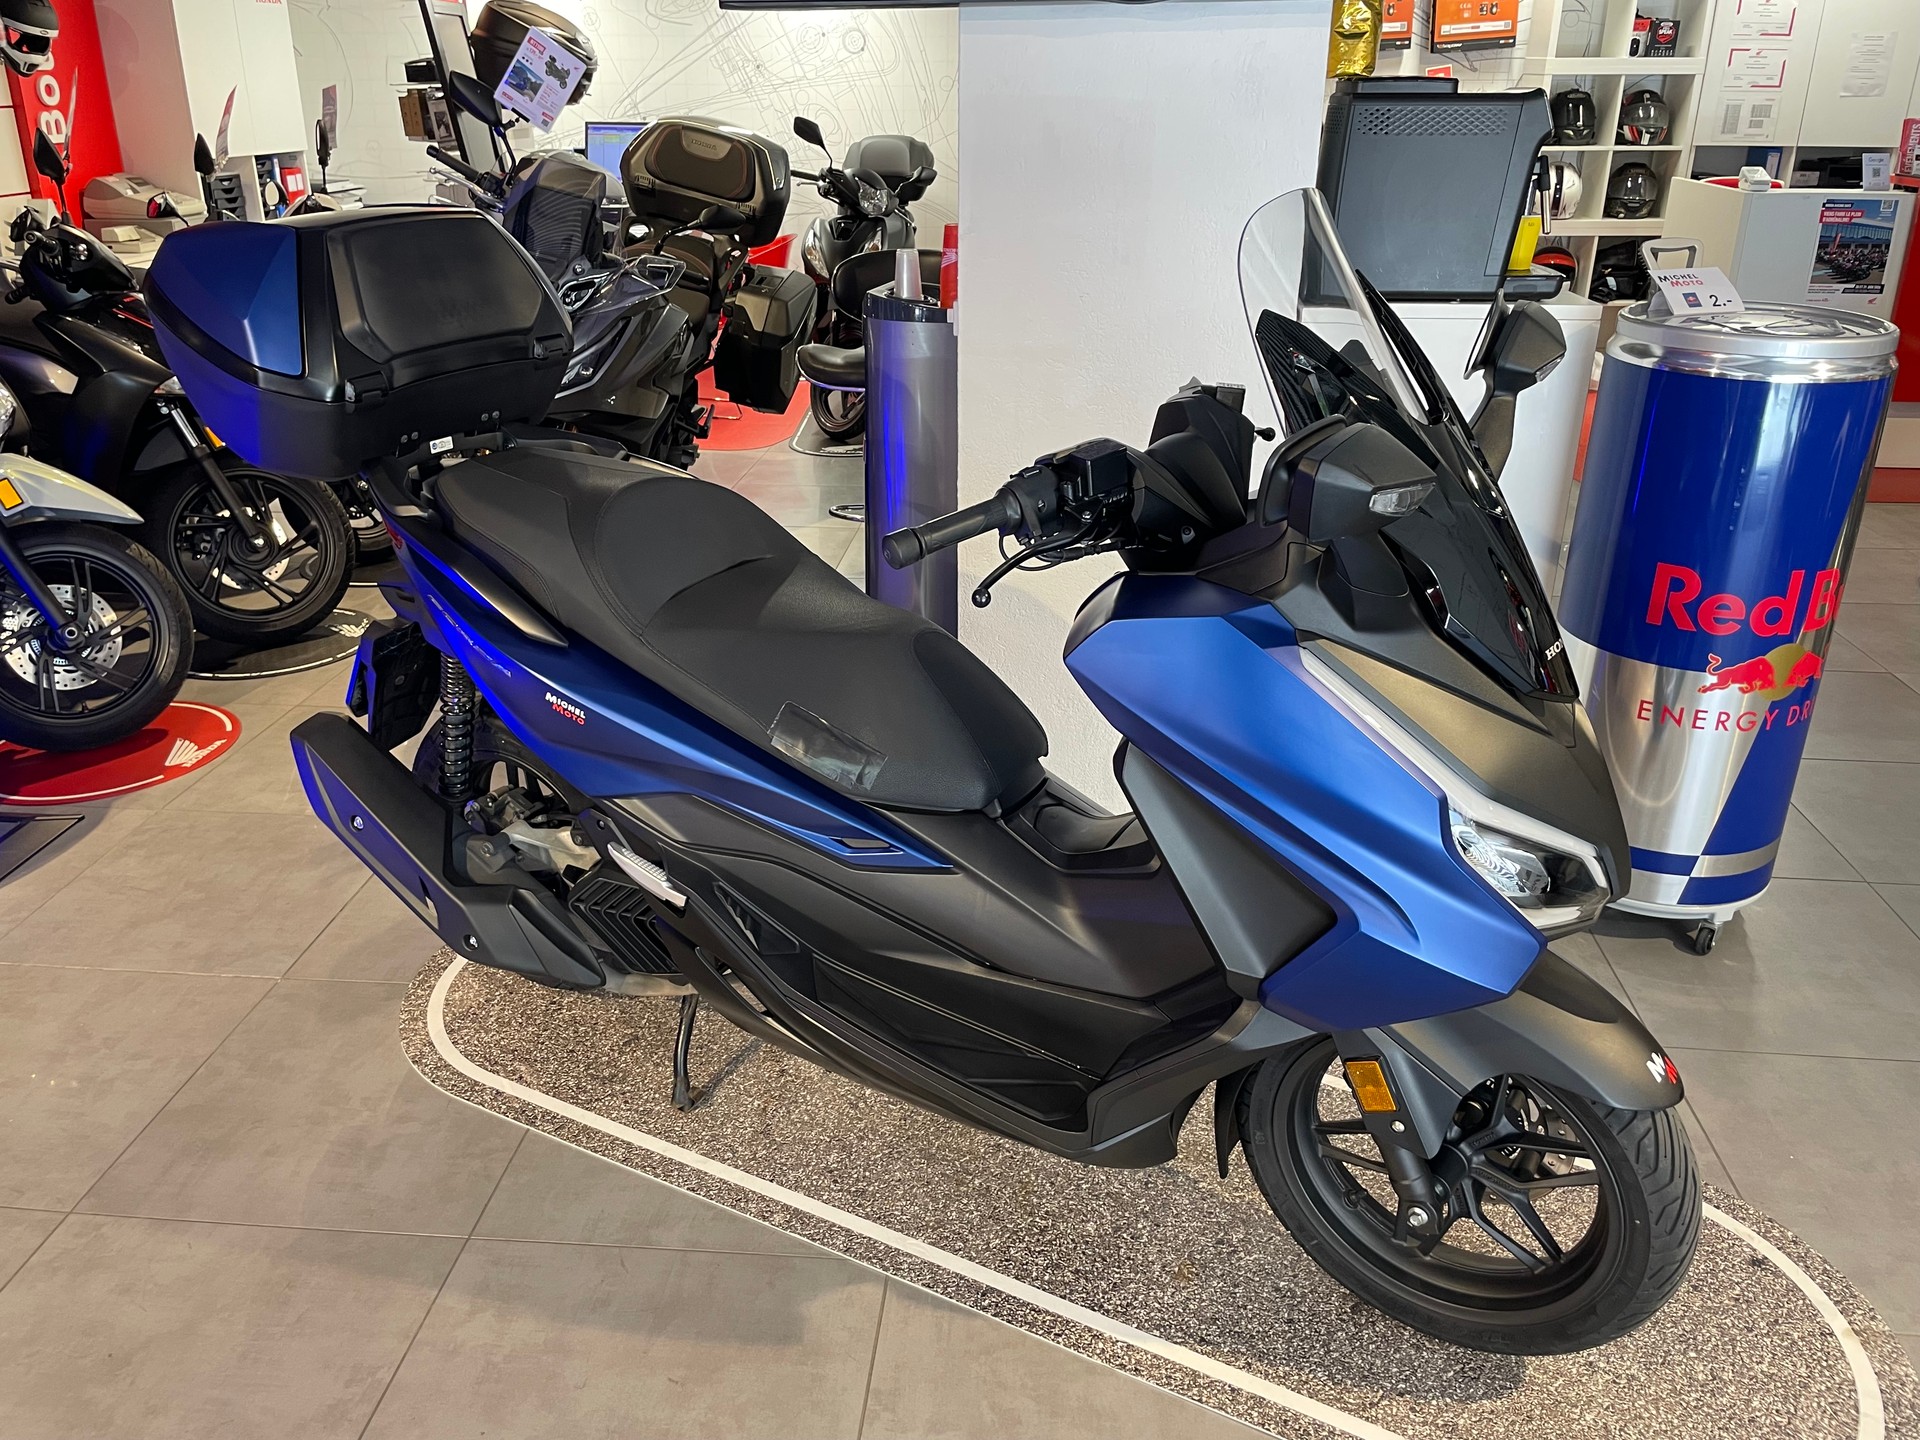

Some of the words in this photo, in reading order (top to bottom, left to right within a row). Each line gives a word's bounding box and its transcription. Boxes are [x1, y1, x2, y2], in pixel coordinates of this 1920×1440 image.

[1657, 273, 1699, 283] MICHEL
[1670, 280, 1704, 288] MOTO
[1646, 562, 1805, 637] Red
[545, 691, 586, 719] MICHEL
[552, 703, 585, 725] MOTO
[1636, 699, 1779, 732] ENERGY
